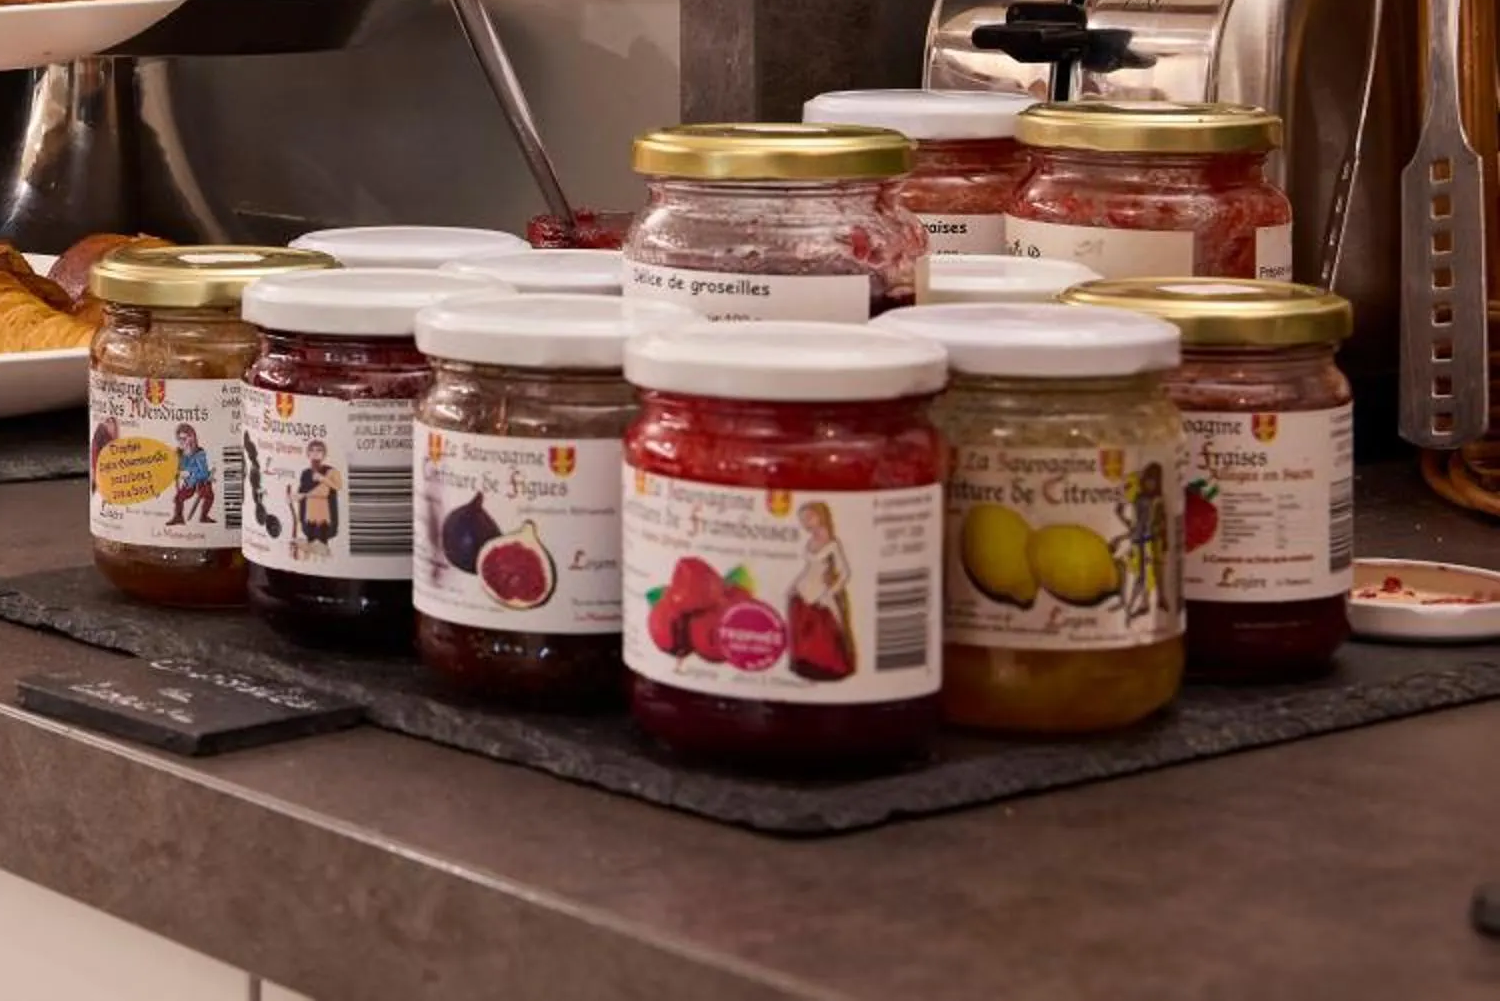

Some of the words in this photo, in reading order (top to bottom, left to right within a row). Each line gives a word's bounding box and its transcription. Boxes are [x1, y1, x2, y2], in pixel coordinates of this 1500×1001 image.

[667, 274, 685, 290] de
[690, 278, 771, 296] groseilles
[263, 409, 328, 441] Sauvages
